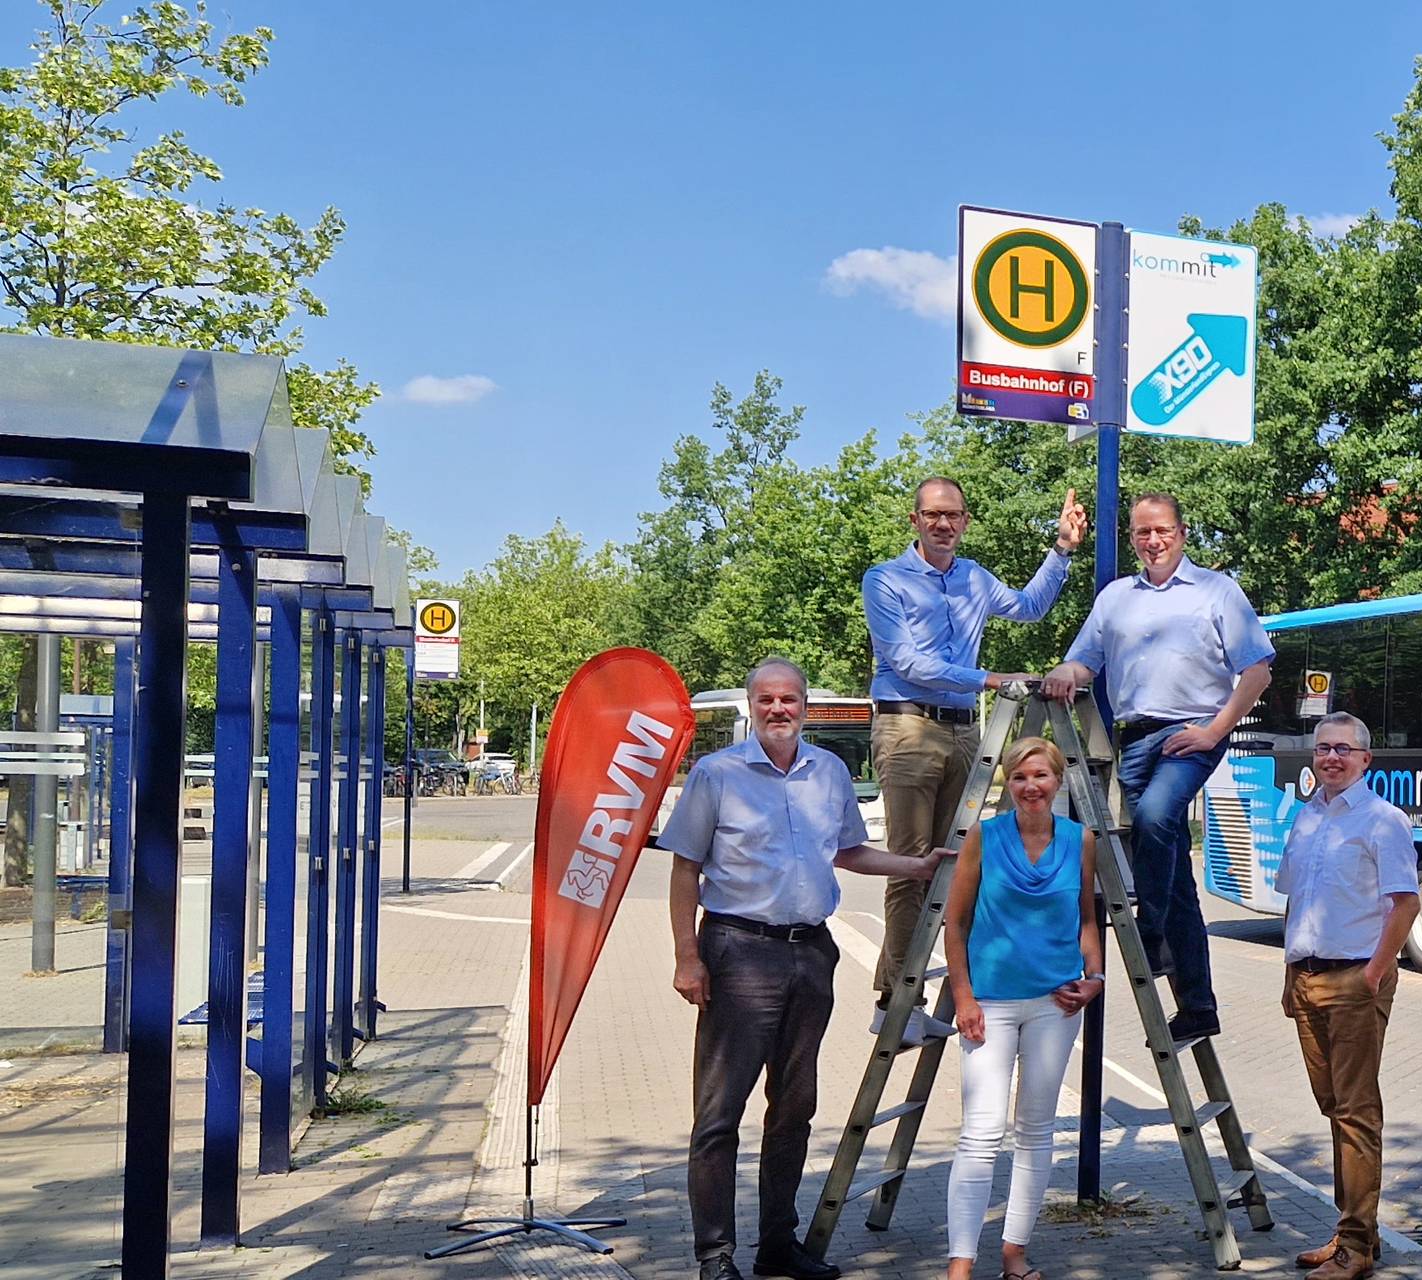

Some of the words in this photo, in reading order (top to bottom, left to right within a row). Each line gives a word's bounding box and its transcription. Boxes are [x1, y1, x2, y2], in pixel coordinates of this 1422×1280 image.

[1133, 248, 1216, 278] kommit
[1009, 255, 1055, 322] H
[1077, 351, 1087, 365] F
[1148, 336, 1213, 405] X90
[969, 369, 1065, 393] Busbahnhof
[1068, 380, 1089, 399] (F)
[430, 609, 446, 628] H
[578, 710, 675, 860] RVM
